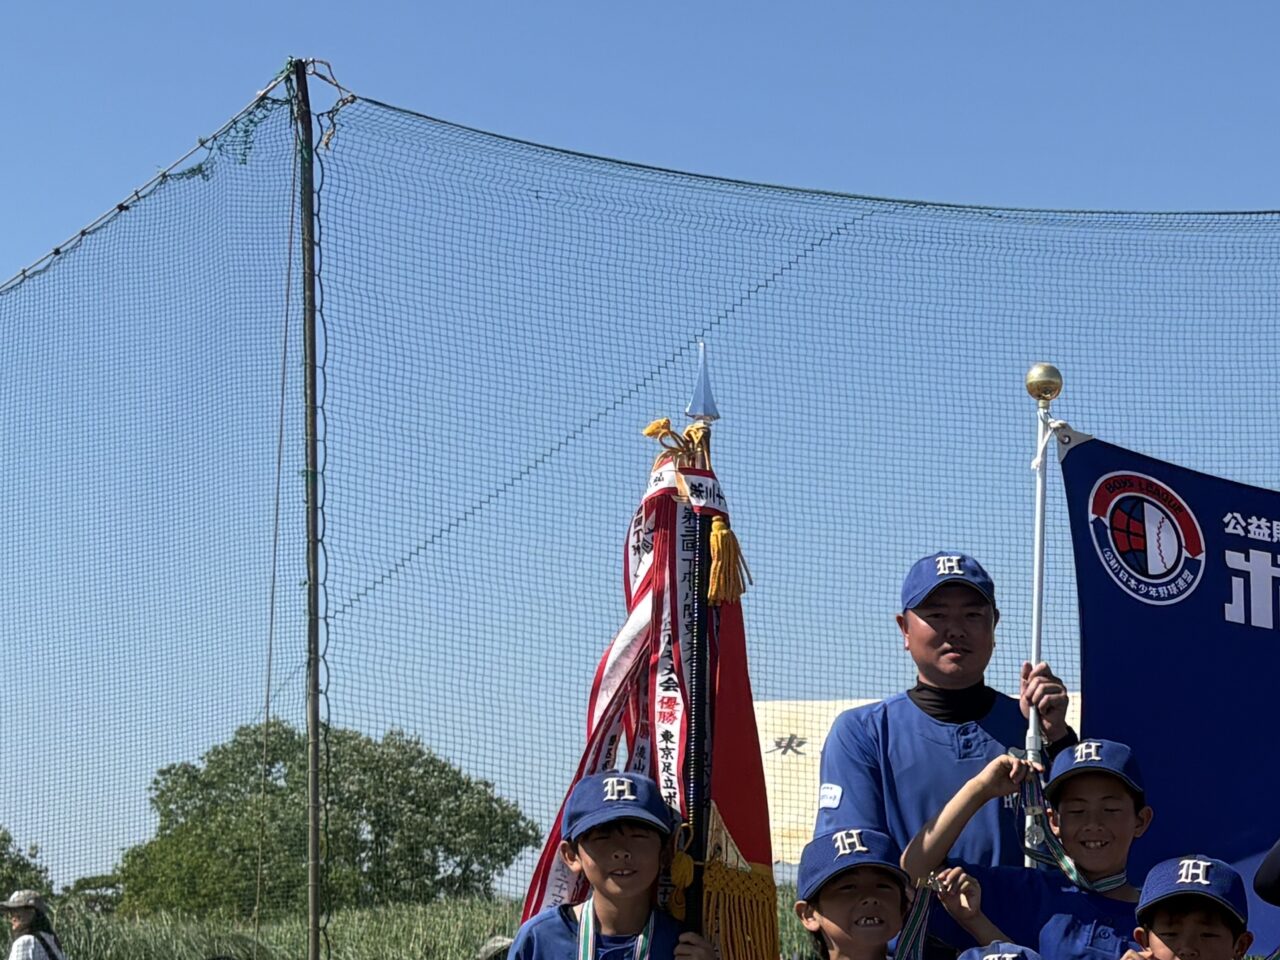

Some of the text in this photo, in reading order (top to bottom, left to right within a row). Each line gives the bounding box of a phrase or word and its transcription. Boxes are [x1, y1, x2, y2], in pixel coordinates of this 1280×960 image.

[1105, 480, 1134, 494] BOYS
[935, 555, 964, 575] H
[657, 696, 681, 725] 優勝
[1074, 741, 1102, 764] H
[603, 776, 637, 802] H
[832, 829, 869, 859] H
[1176, 859, 1212, 885] H
